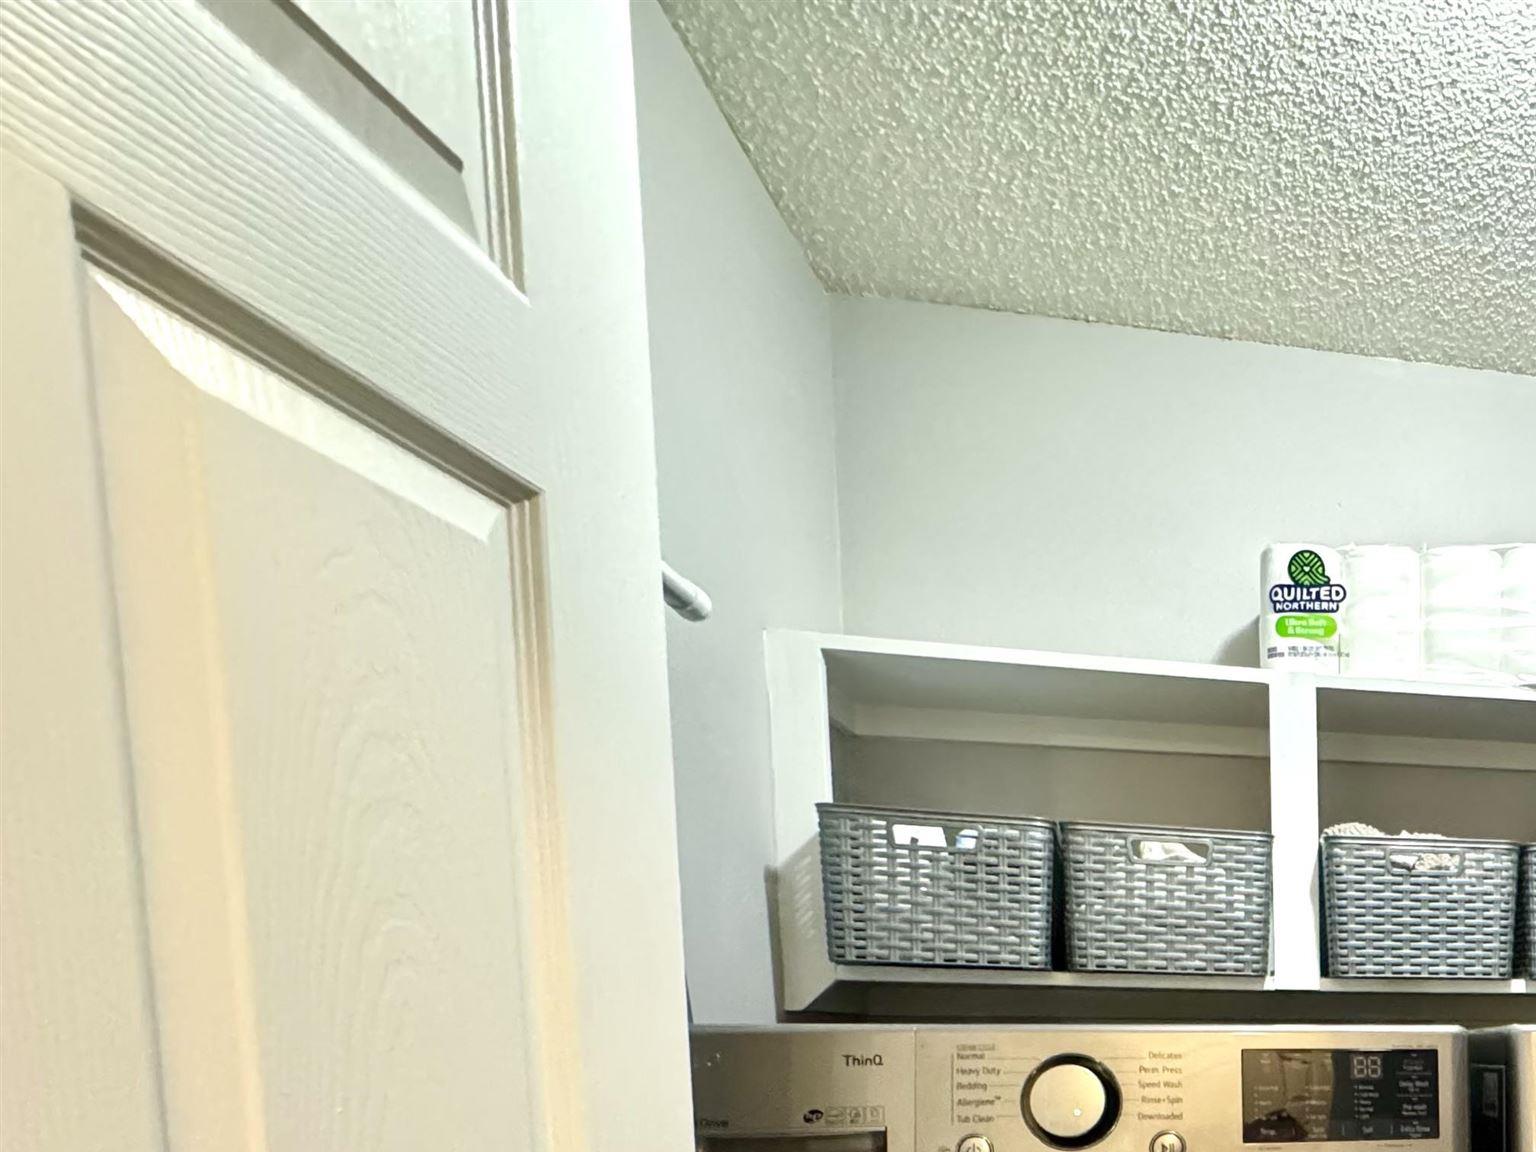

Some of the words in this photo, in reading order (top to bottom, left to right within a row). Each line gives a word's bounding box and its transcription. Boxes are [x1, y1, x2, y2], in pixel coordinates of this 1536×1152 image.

[1271, 586, 1345, 602] QUILTED
[1275, 601, 1338, 611] NORTHERN
[842, 1053, 884, 1067] ThinQ
[1148, 1050, 1183, 1060] Delicates
[956, 1068, 980, 1076] Heavy
[981, 1066, 1002, 1076] Duty
[956, 1082, 988, 1091] Bedding
[1138, 1079, 1161, 1089] Speed
[1162, 1080, 1183, 1088] Wash
